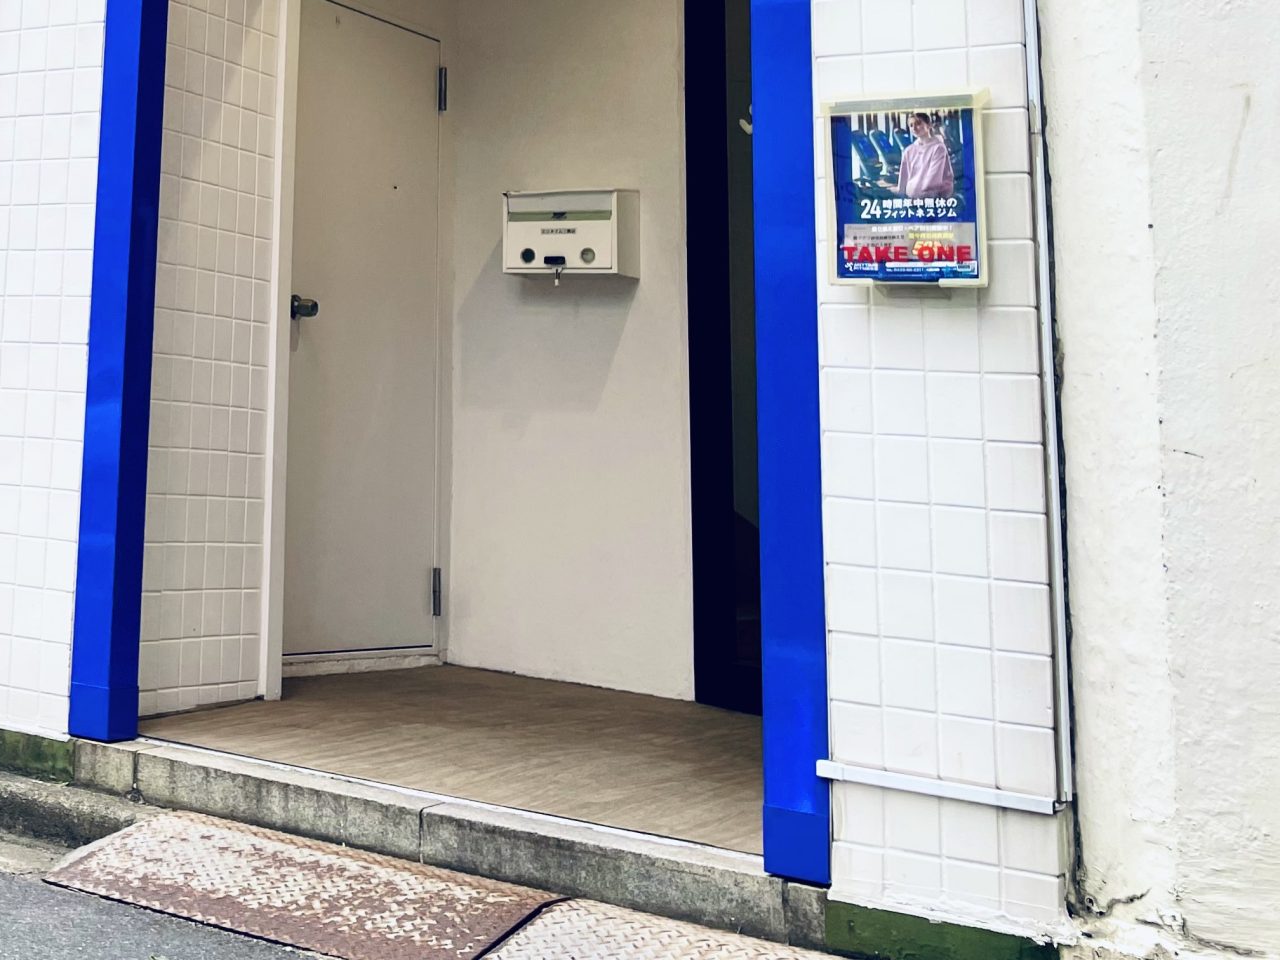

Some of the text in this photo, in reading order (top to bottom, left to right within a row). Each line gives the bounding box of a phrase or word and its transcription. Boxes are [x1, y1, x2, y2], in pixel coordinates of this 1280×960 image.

[860, 198, 881, 219] 24
[883, 208, 957, 219] フィットネスジム
[841, 245, 909, 263] TAKE
[917, 245, 973, 263] ONE
